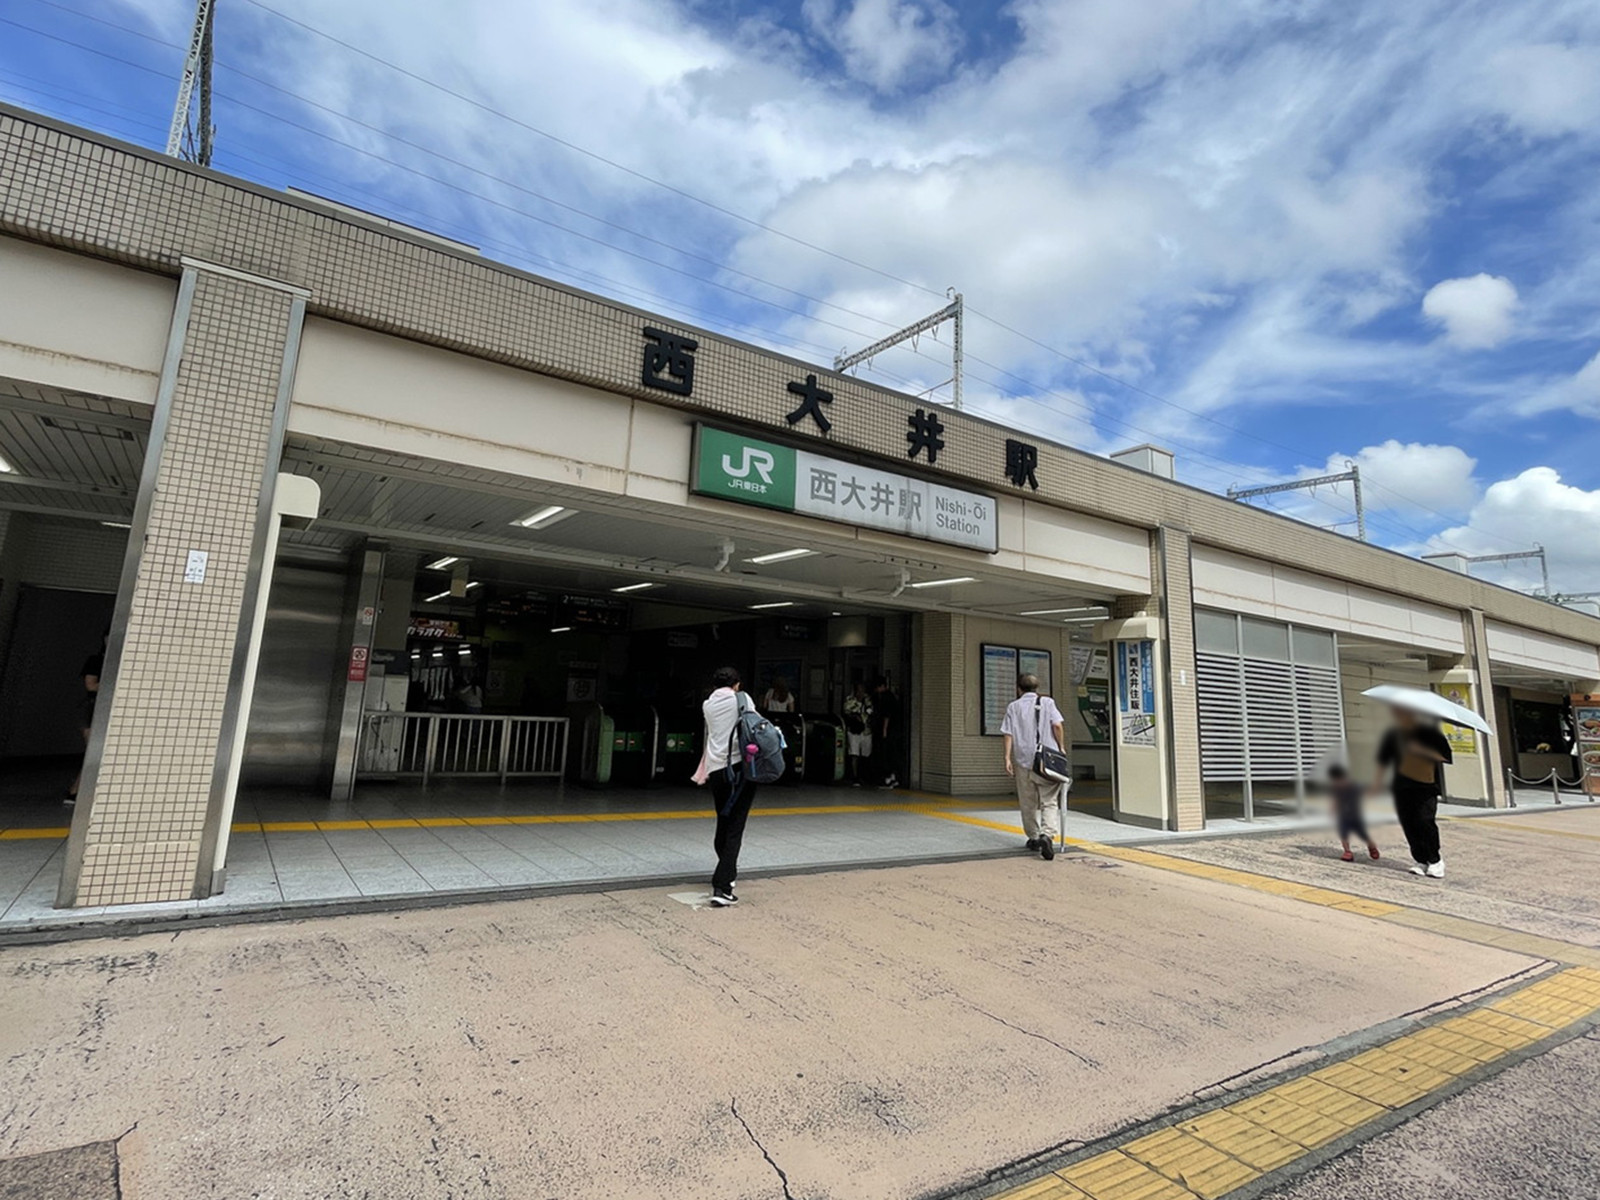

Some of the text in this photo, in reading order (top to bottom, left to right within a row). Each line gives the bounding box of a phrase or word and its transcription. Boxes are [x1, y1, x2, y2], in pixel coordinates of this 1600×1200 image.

[642, 326, 1039, 491] 西大井駅
[722, 446, 774, 484] JR
[727, 479, 767, 494] JR東日本
[810, 467, 921, 521] 西大井駅
[935, 496, 987, 521] Nishi-Ōi
[936, 513, 980, 536] Station
